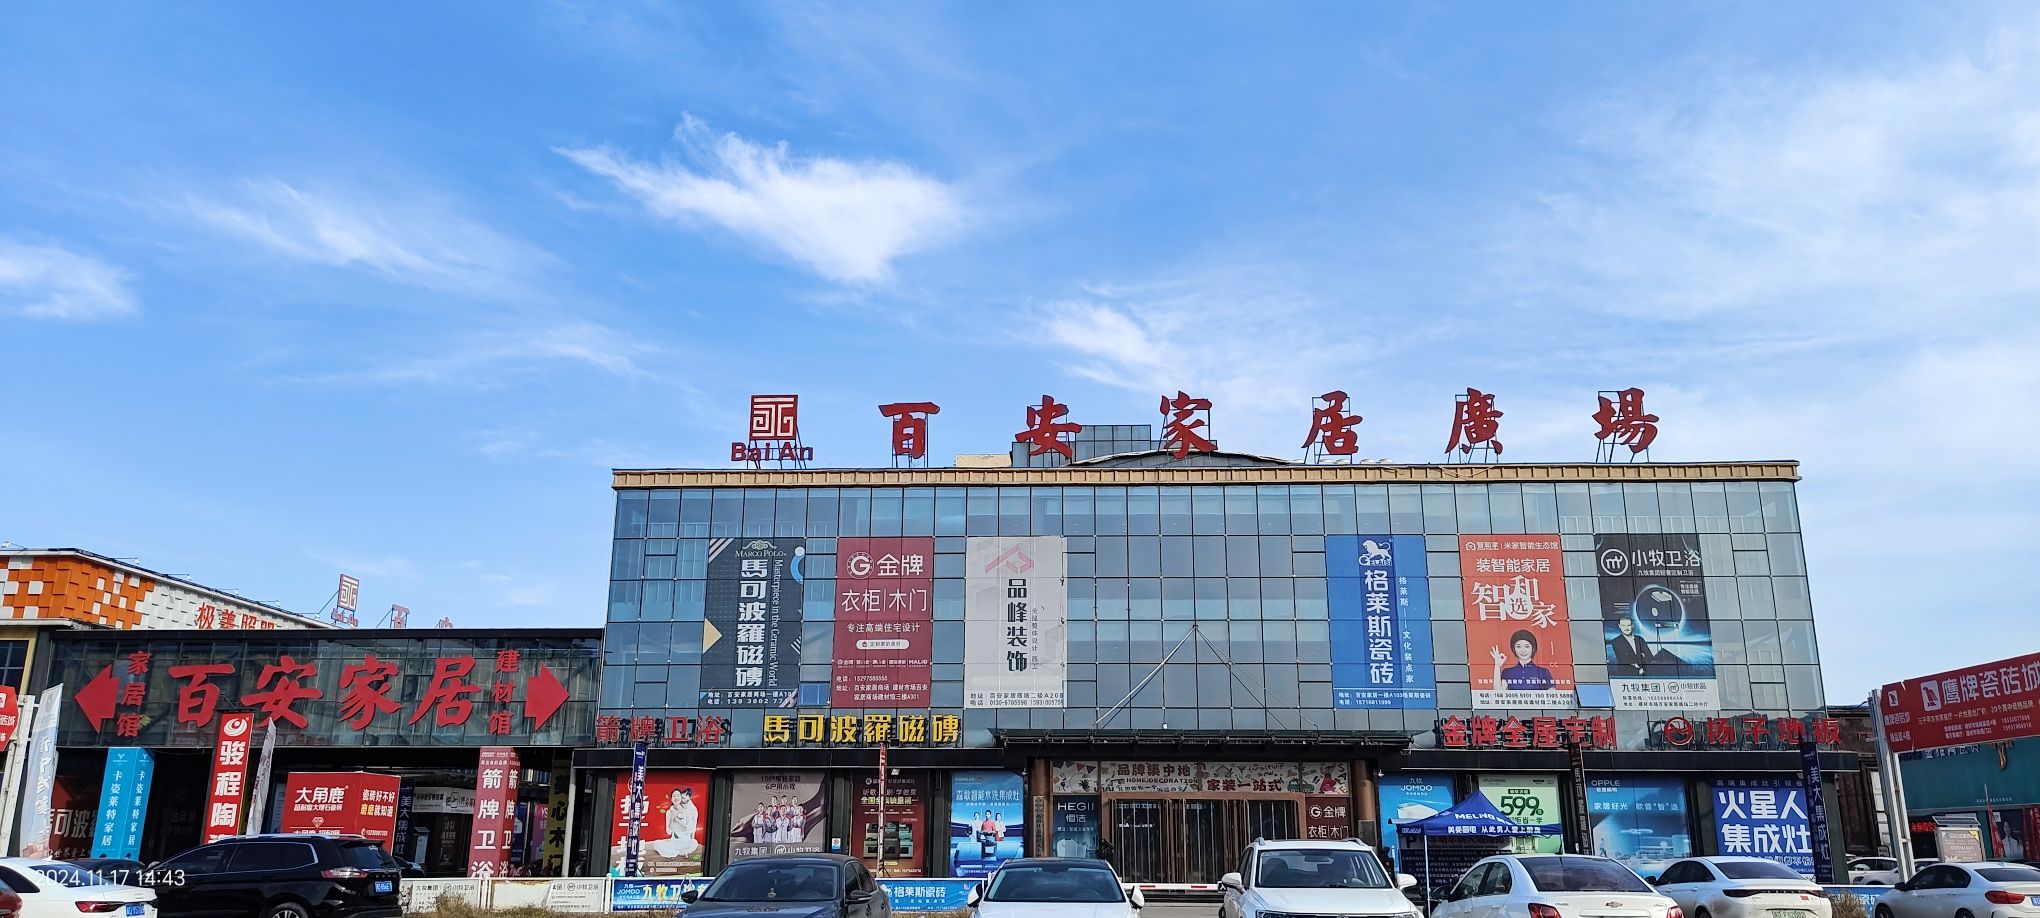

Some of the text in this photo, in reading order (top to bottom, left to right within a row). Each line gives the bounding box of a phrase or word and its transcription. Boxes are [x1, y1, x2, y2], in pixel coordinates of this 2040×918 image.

[878, 388, 1660, 459] 百安家居廣場
[731, 441, 814, 461] Bai An
[735, 549, 784, 558] MARCO POLO
[876, 553, 924, 576] 金牌
[1476, 558, 1551, 573] 装智能家居
[1632, 549, 1702, 567] 小牧卫浴
[771, 559, 784, 605] Masterpiece
[841, 588, 927, 612] 衣柜 木门
[735, 559, 768, 687] 馬可波羅磁磚
[846, 622, 920, 633] 专注高端住宅设计
[1006, 578, 1028, 672] 品峰装饰
[1364, 570, 1394, 684] 格莱斯瓷砖
[117, 650, 152, 739] 家居馆
[168, 654, 482, 731] 百安家居
[488, 648, 521, 737] 建材馆
[1621, 683, 1660, 692] 九牧集团
[1941, 660, 2040, 705] 鹰牌瓷砖城
[595, 714, 725, 744] 箭牌卫浴
[762, 714, 960, 744] 馬可波羅磁磚
[1441, 715, 1617, 748] 金牌全屋定制
[1706, 716, 1841, 745] 扬子地板
[1117, 764, 1191, 777] 品牌集中地
[1206, 779, 1283, 791] 家装一站式
[1591, 779, 1621, 787] OPPLE
[208, 740, 246, 843] 骏程陶
[294, 786, 345, 804] 大角鹿
[362, 788, 396, 803] 瓷砖好不好
[1501, 796, 1540, 816] 599
[1718, 790, 1809, 820] 火星人
[101, 770, 124, 846] 卡姿莱特家居
[128, 770, 146, 846] 卡姿莱特家居
[1057, 802, 1095, 811] HEGII
[1324, 805, 1346, 818] 金牌
[1594, 803, 1629, 811] 家居好光
[1810, 766, 1831, 860] 美大集成灶
[395, 795, 412, 854] 美大集成灶
[470, 768, 504, 877] 箭牌卫浴
[735, 846, 768, 856] 九牧集团
[1721, 823, 1813, 854] 集成灶
[894, 886, 947, 898] 格莱斯瓷砖
